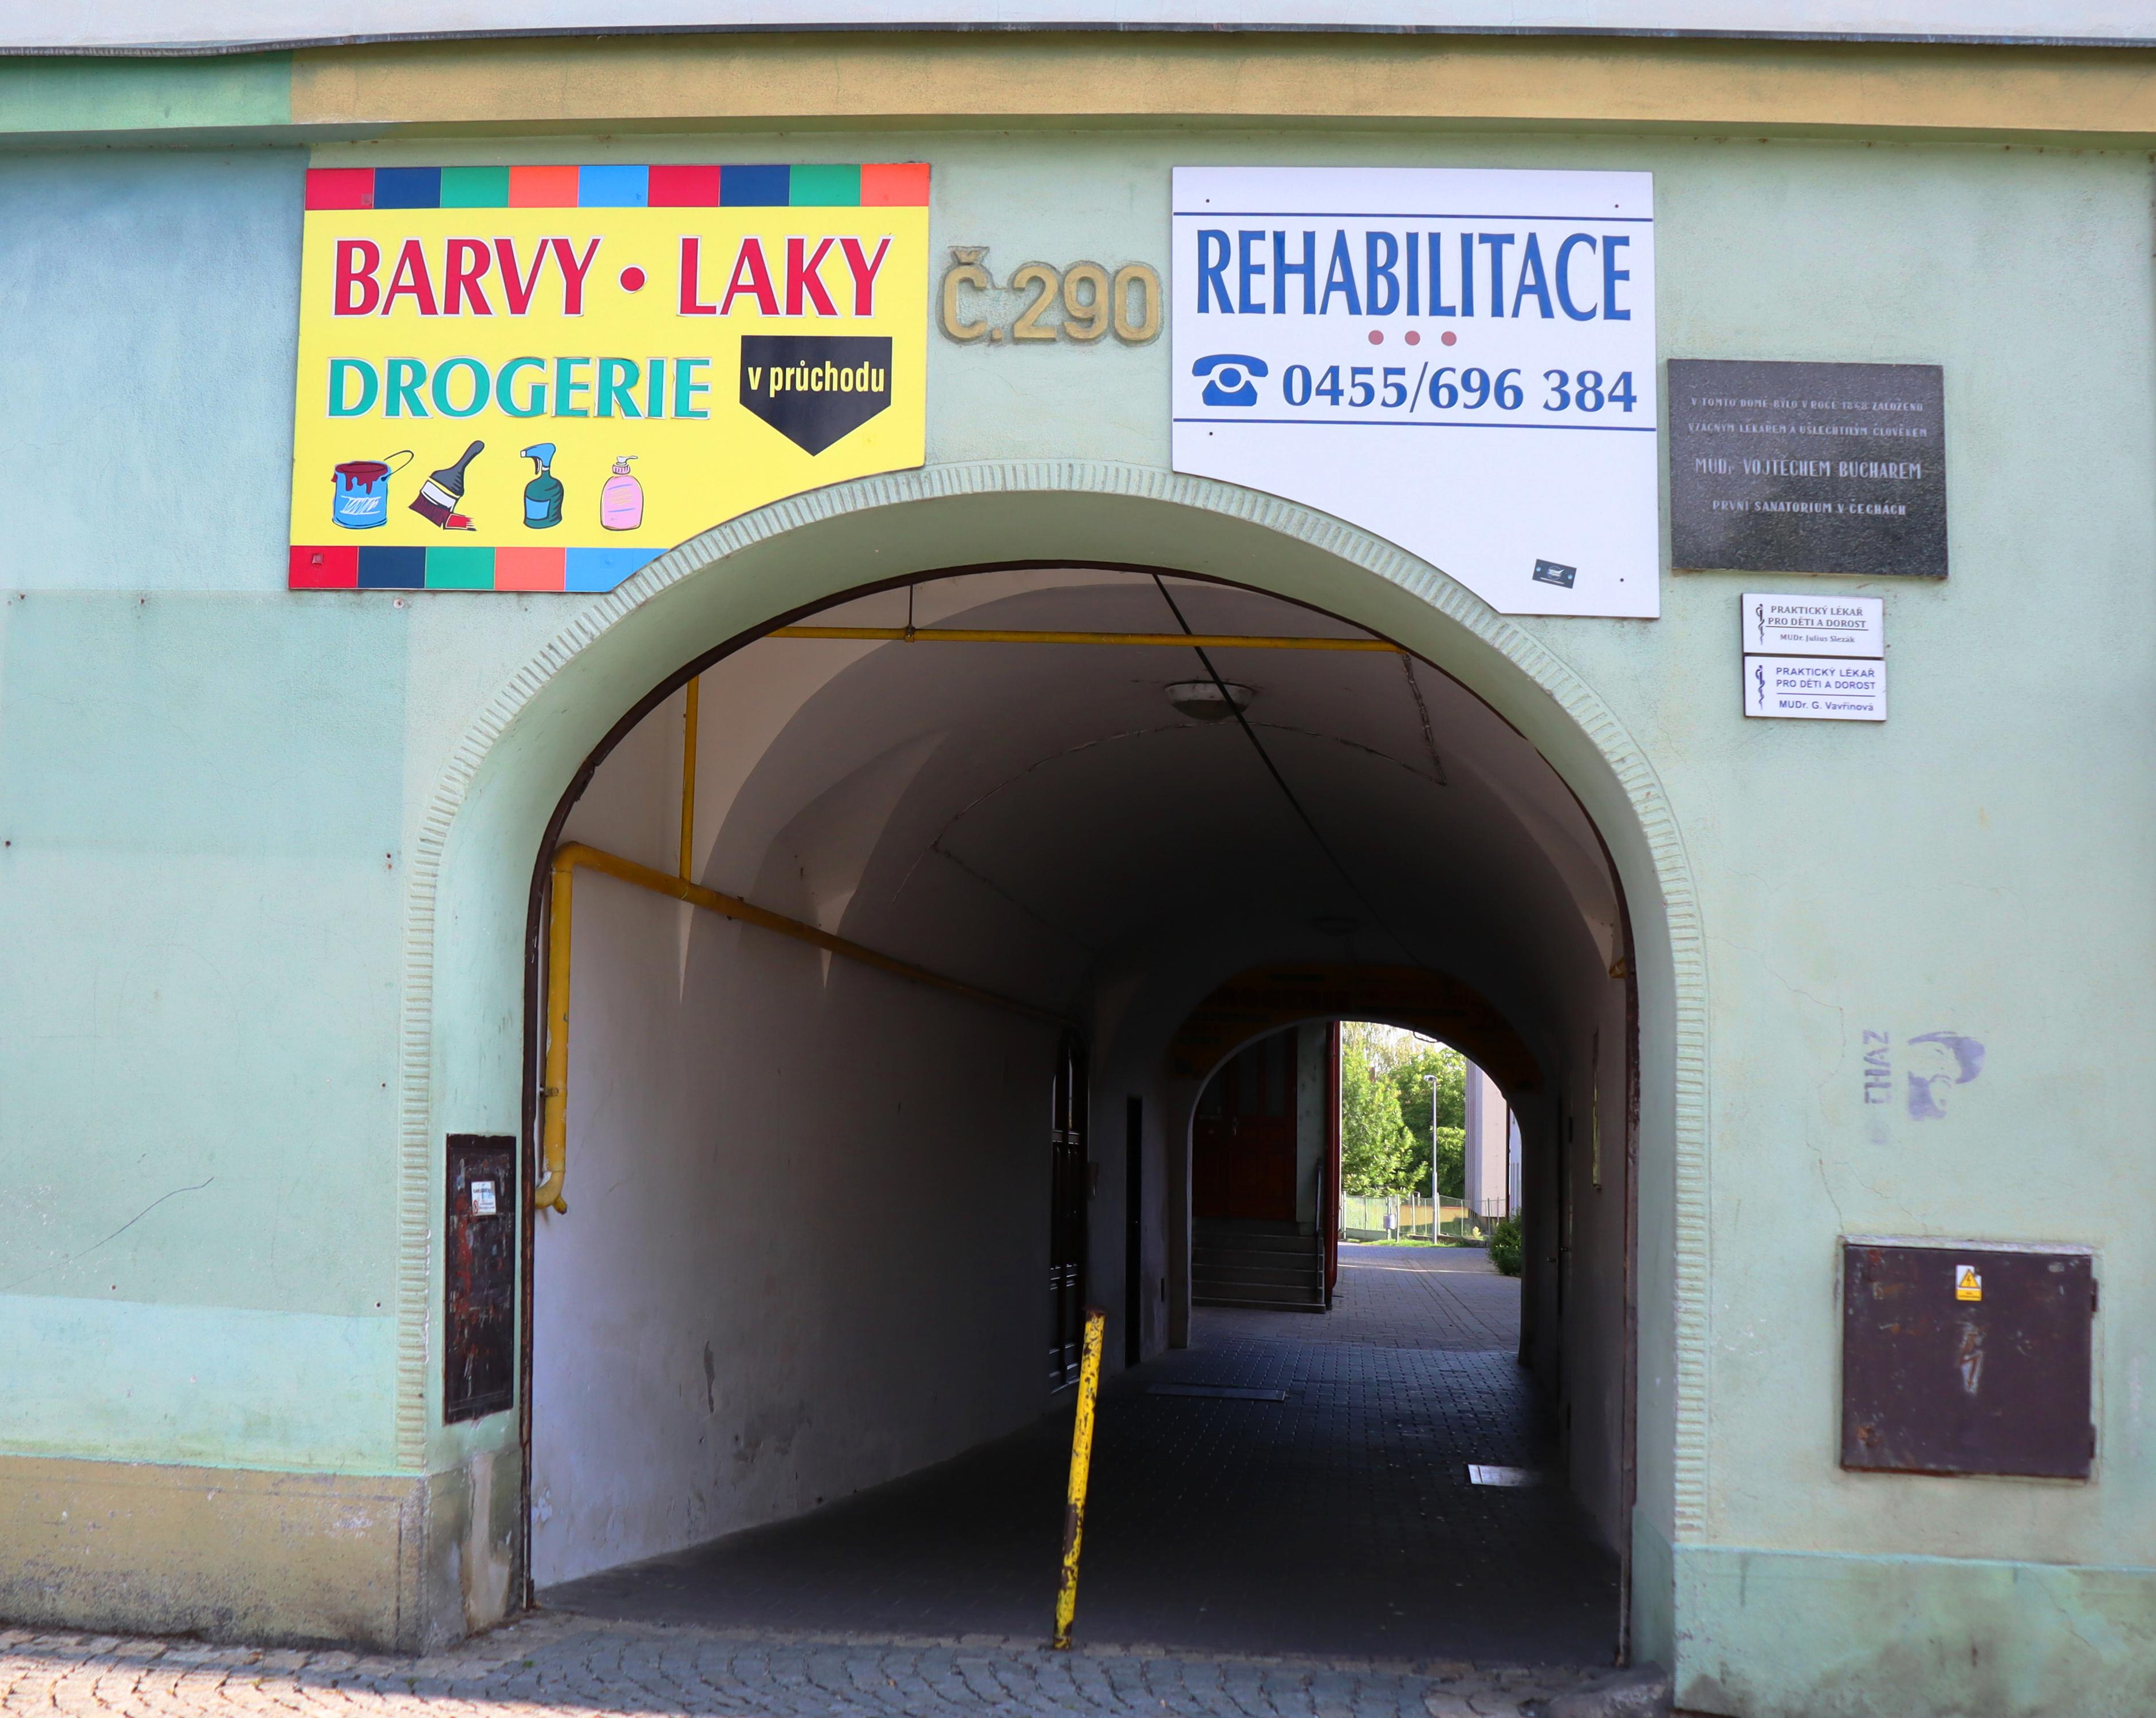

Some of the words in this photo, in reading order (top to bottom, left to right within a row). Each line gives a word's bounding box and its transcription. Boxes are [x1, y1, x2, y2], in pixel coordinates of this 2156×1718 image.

[332, 237, 601, 318] BARVY
[678, 235, 894, 318] LAKY
[1196, 229, 1632, 322] REHABILITACE
[943, 249, 1159, 342] Č.290
[748, 368, 761, 389] v
[770, 358, 886, 399] průchodu
[1282, 361, 1524, 413] 0455/696
[1543, 370, 1638, 413] 384
[325, 356, 713, 420] DROGERIE
[1691, 397, 1697, 406] V
[1702, 397, 1736, 407] TOMTO
[1740, 396, 1768, 408] DOMĚ
[1773, 399, 1797, 408] BYLO
[1802, 400, 1808, 408] V
[1811, 400, 1839, 410] ROCE
[1872, 397, 1923, 412] ZALOŽENO
[1688, 419, 1734, 433] VZÁCNÝM
[1740, 419, 1787, 434] LÉKAŘEM
[1789, 424, 1796, 434] A
[1799, 421, 1868, 436] UŠLECHTILÝM
[1873, 422, 1927, 438] ČLOVĚKEM
[1743, 454, 1831, 478] VOJTĚCHEM
[1839, 460, 1922, 480] BUCHAREM
[1713, 497, 1750, 511] PRVNÍ
[1754, 501, 1833, 514] SANATORIUM
[1838, 503, 1845, 514] V
[1850, 498, 1906, 515] ČECHÁCH
[1771, 605, 1828, 616] PRAKTICKÝ
[1831, 606, 1863, 617] LÉKAŘ
[1768, 617, 1788, 626] PRO
[1791, 616, 1815, 627] DĚTI
[1817, 619, 1823, 627] A
[1826, 620, 1867, 629] DOROST
[1805, 635, 1828, 643] Julius
[1776, 667, 1836, 677] PRAKTICKÝ
[1839, 667, 1875, 678] LÉKAŘ
[1776, 679, 1797, 688] PRO
[1800, 678, 1822, 688] DĚTI
[1824, 680, 1832, 689] A
[1835, 681, 1876, 690] DOROST
[1779, 700, 1809, 709] MUDr.
[1811, 701, 1823, 710] G.
